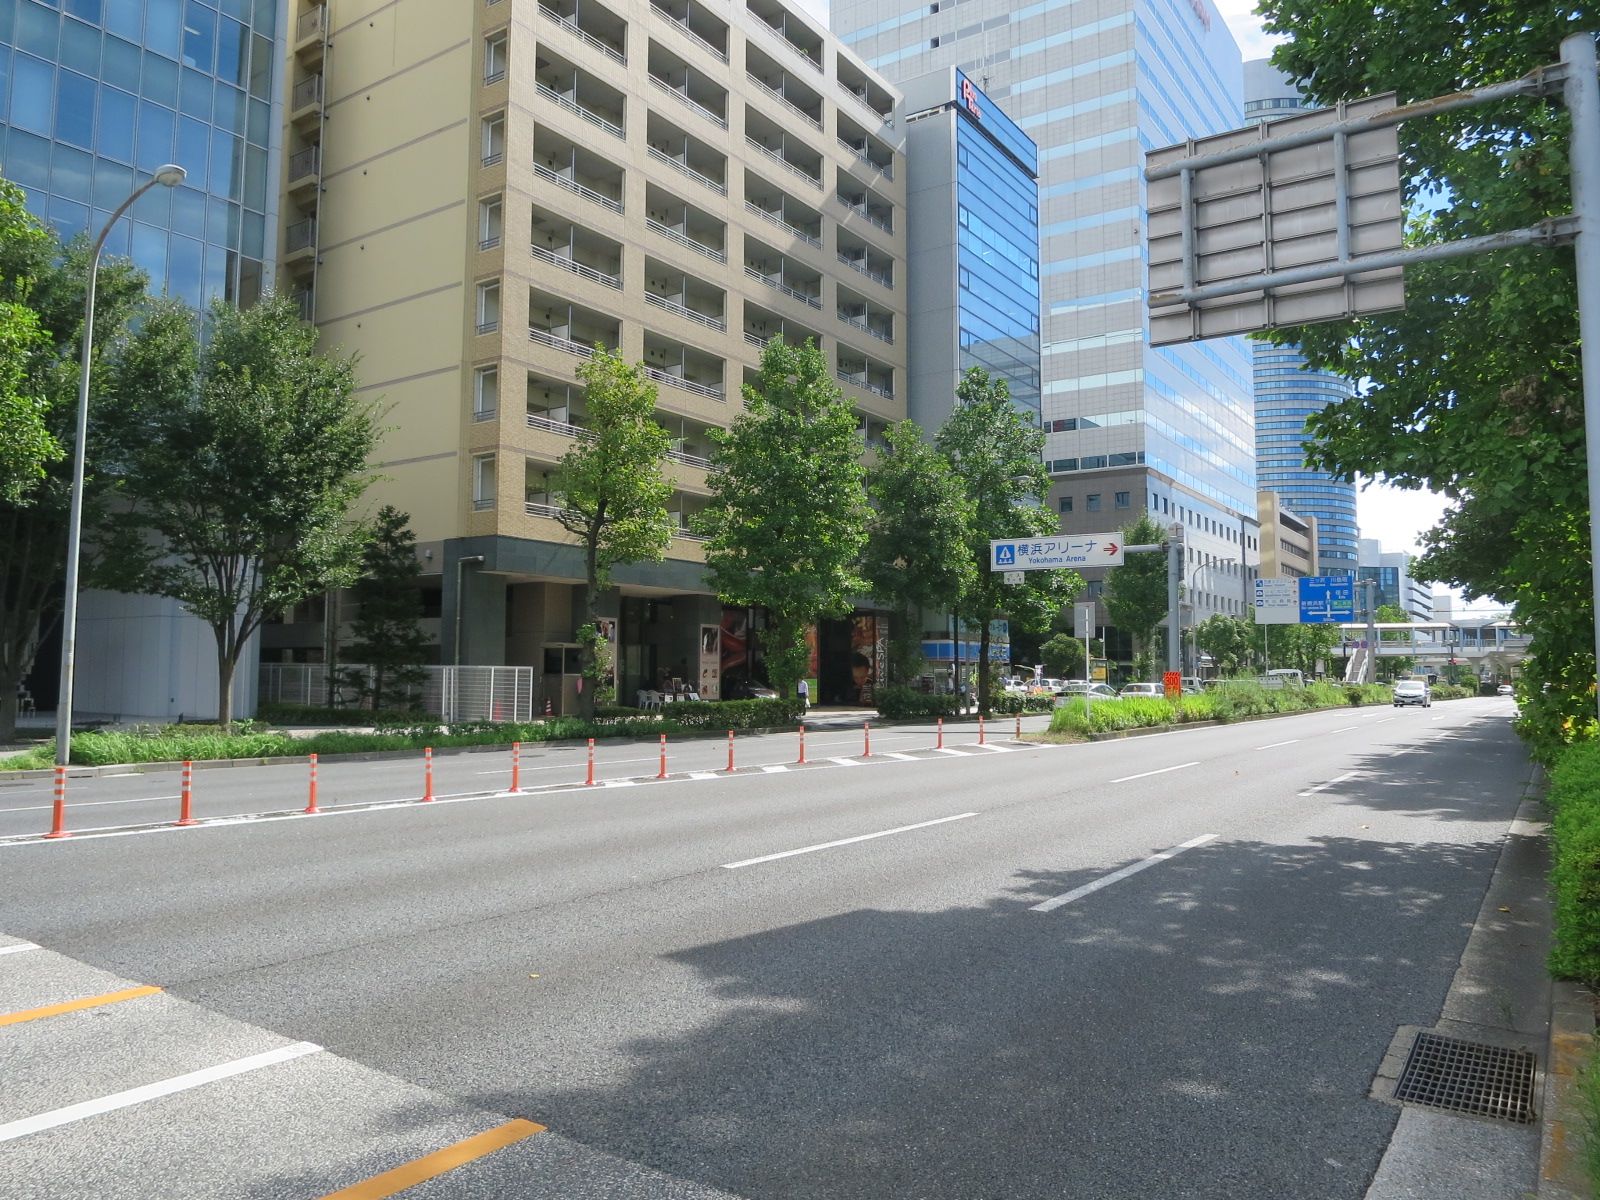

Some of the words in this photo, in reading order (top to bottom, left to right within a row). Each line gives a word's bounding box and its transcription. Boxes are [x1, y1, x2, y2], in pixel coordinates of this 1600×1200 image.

[1018, 540, 1097, 556] 横浜アリーナ
